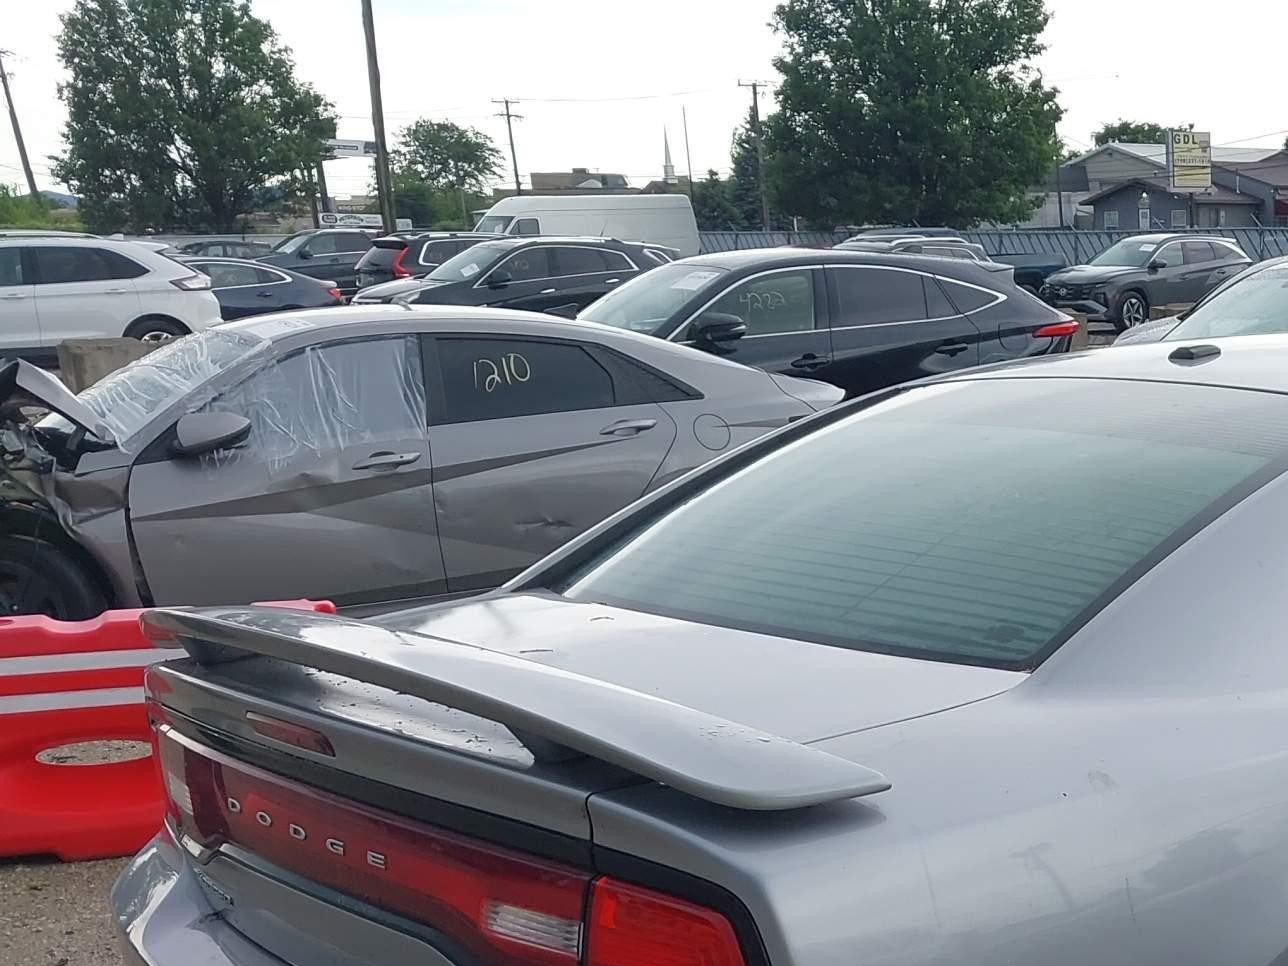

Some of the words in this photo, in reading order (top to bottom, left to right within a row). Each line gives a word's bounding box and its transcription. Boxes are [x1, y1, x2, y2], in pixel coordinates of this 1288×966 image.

[1173, 133, 1199, 145] GDL
[473, 353, 531, 393] 1210
[227, 797, 387, 870] DODGE
